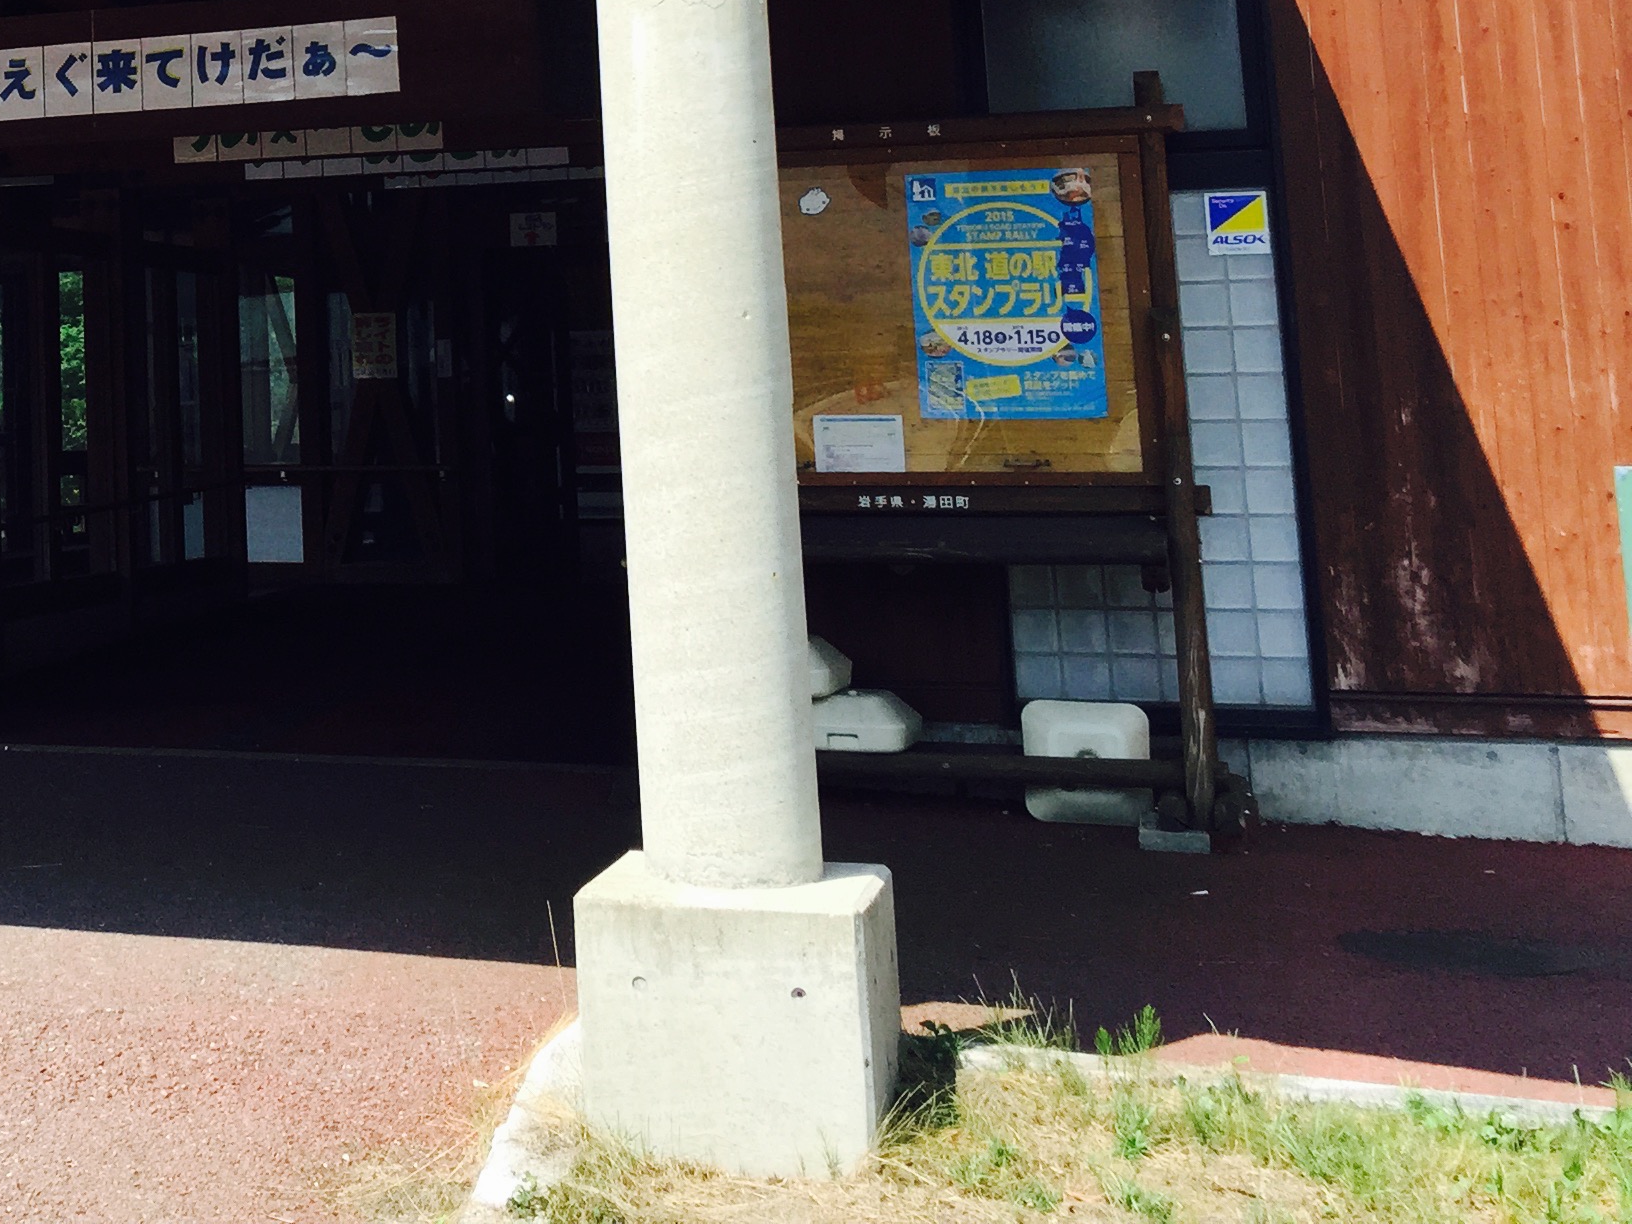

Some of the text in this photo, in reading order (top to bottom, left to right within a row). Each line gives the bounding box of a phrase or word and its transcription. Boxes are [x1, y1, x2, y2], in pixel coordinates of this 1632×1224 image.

[985, 211, 1015, 222] 2015
[966, 230, 1037, 242] STAMP RALLY
[1212, 234, 1266, 245] ALSOK
[929, 251, 1057, 281] 東北 道の駅
[927, 281, 1085, 316] スタンプラリー
